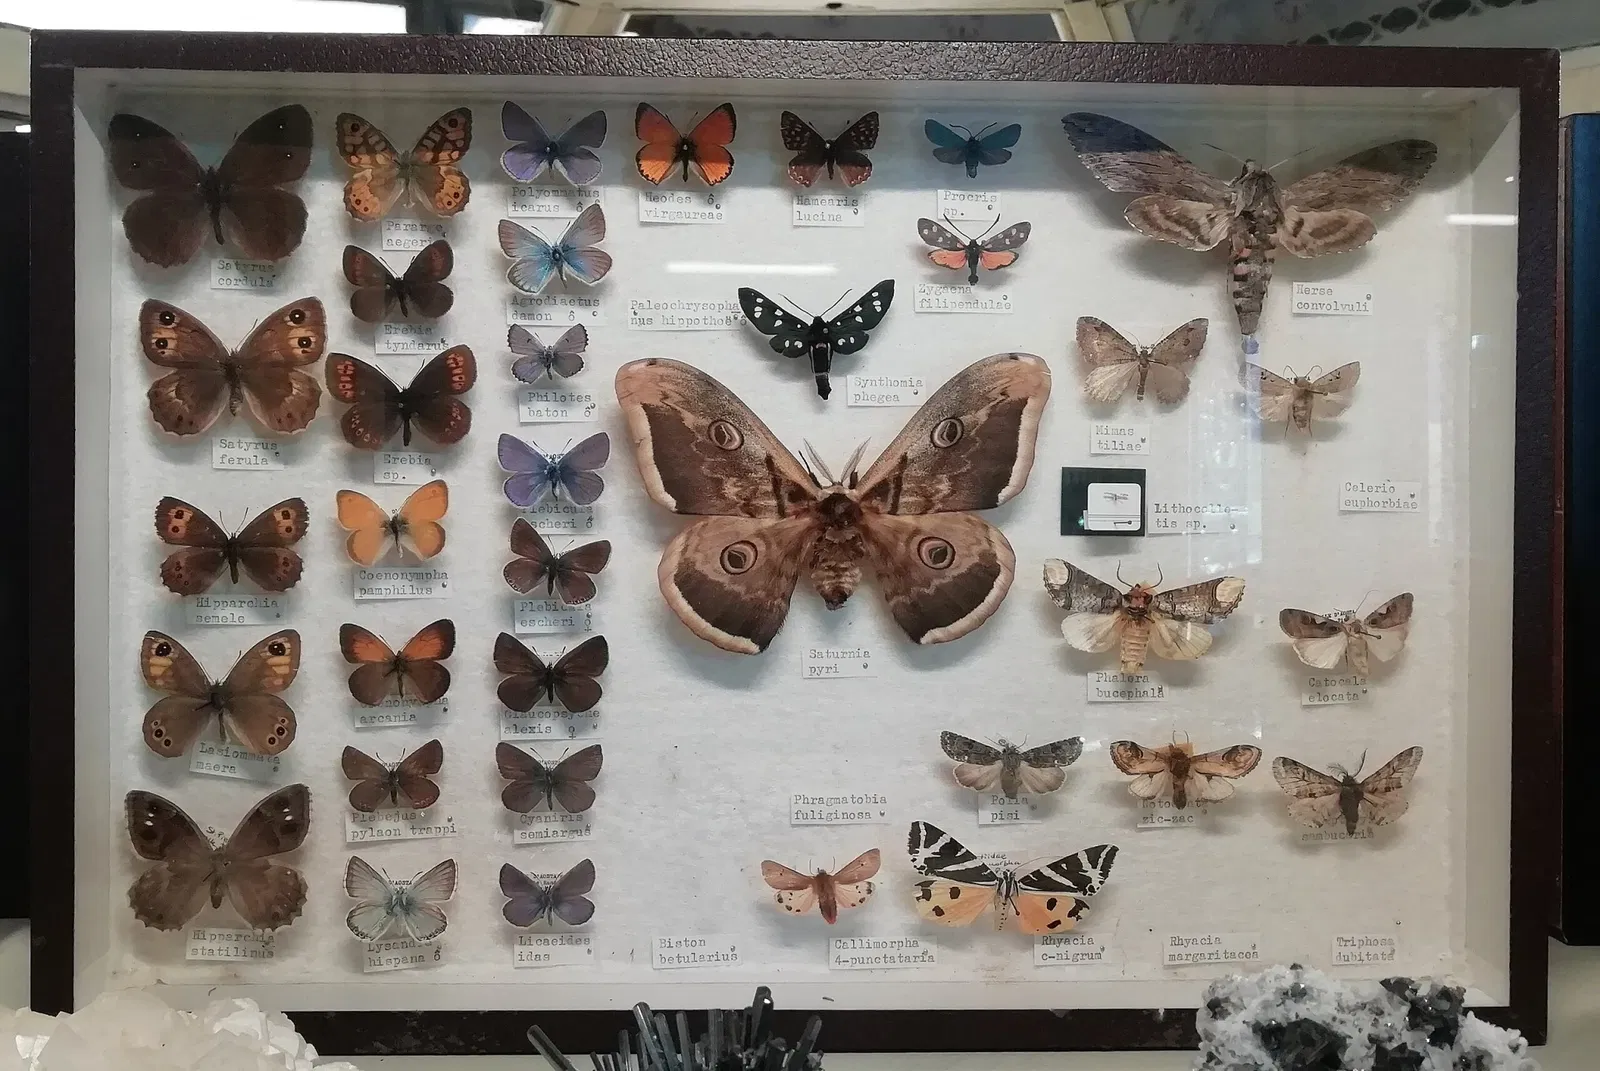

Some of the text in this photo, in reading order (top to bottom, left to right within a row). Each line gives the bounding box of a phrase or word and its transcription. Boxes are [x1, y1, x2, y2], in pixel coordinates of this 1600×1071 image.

[512, 186, 599, 199] Polyommatus
[645, 192, 692, 204] Heodes
[944, 190, 997, 203] Procris
[512, 201, 560, 213] icarus
[796, 195, 859, 207] Hamearis
[645, 208, 723, 222] virgaureae
[796, 210, 843, 222] lucina
[944, 208, 964, 219] sp.
[386, 236, 434, 249] aegeri
[218, 259, 275, 273] Satyrus
[218, 275, 274, 288] cordula
[918, 284, 972, 296] Zygaena
[1296, 284, 1333, 295] Herse
[511, 295, 600, 309] Agrodiaetus
[918, 298, 1012, 312] filipendulae
[1296, 300, 1369, 312] convolvuli
[512, 310, 552, 321] damon
[630, 316, 653, 326] nus
[384, 324, 432, 336] Erebia
[385, 340, 449, 352] tyndarus
[854, 376, 924, 388] Synthomia
[528, 391, 591, 403] Philotes
[853, 392, 900, 405] phegea
[528, 406, 568, 418] baton
[1096, 425, 1134, 436] Mimas
[220, 438, 278, 451] Satyrus
[1096, 439, 1142, 451] tiliae
[220, 454, 269, 466] ferula
[383, 453, 432, 466] Erebia
[383, 471, 406, 482] sp.
[1345, 481, 1395, 493] Celerio
[1345, 497, 1418, 509] euphorbiae
[530, 518, 577, 529] scheri
[1155, 518, 1207, 531] tis sp.
[359, 569, 449, 582] Coenonympha
[359, 585, 432, 598] pamphilus
[196, 597, 279, 610] Hipparchia
[196, 612, 245, 624] semele
[520, 616, 575, 627] escheri
[809, 648, 871, 659] Saturnia
[808, 662, 840, 676] pyri
[1096, 672, 1150, 683] Phalera
[1308, 675, 1367, 688] Catocala
[1096, 687, 1165, 700] bucephala
[1308, 691, 1360, 703] elocata
[360, 712, 417, 724] arcania
[504, 723, 552, 734] alexis
[196, 760, 237, 774] maera
[794, 793, 887, 806] Phragmatobia
[351, 811, 417, 824] Plebejus
[519, 813, 584, 825] Cyaniris
[794, 809, 872, 823] fuliginosa
[991, 809, 1020, 823] pisi
[1142, 814, 1195, 824] zic-zac
[351, 823, 457, 840] pylaon trappi
[520, 827, 591, 840] semiargus
[192, 930, 275, 943] Hipparchia
[518, 935, 591, 946] Licaeides
[659, 937, 706, 948] Biston
[1042, 935, 1095, 948] Rhyacia
[1169, 935, 1222, 947] Rhyacia
[1336, 936, 1395, 949] Triphosa
[367, 940, 432, 953] Lysanda
[835, 938, 919, 951] Callimorpha
[191, 946, 275, 959] statilinus
[518, 951, 551, 962] idas
[659, 952, 738, 964] betularius
[1041, 951, 1102, 962] c-nigrum
[1168, 950, 1259, 962] margaritacea
[1336, 951, 1395, 963] dubitata
[368, 954, 425, 967] hispana
[835, 953, 935, 966] 4-punctataria
